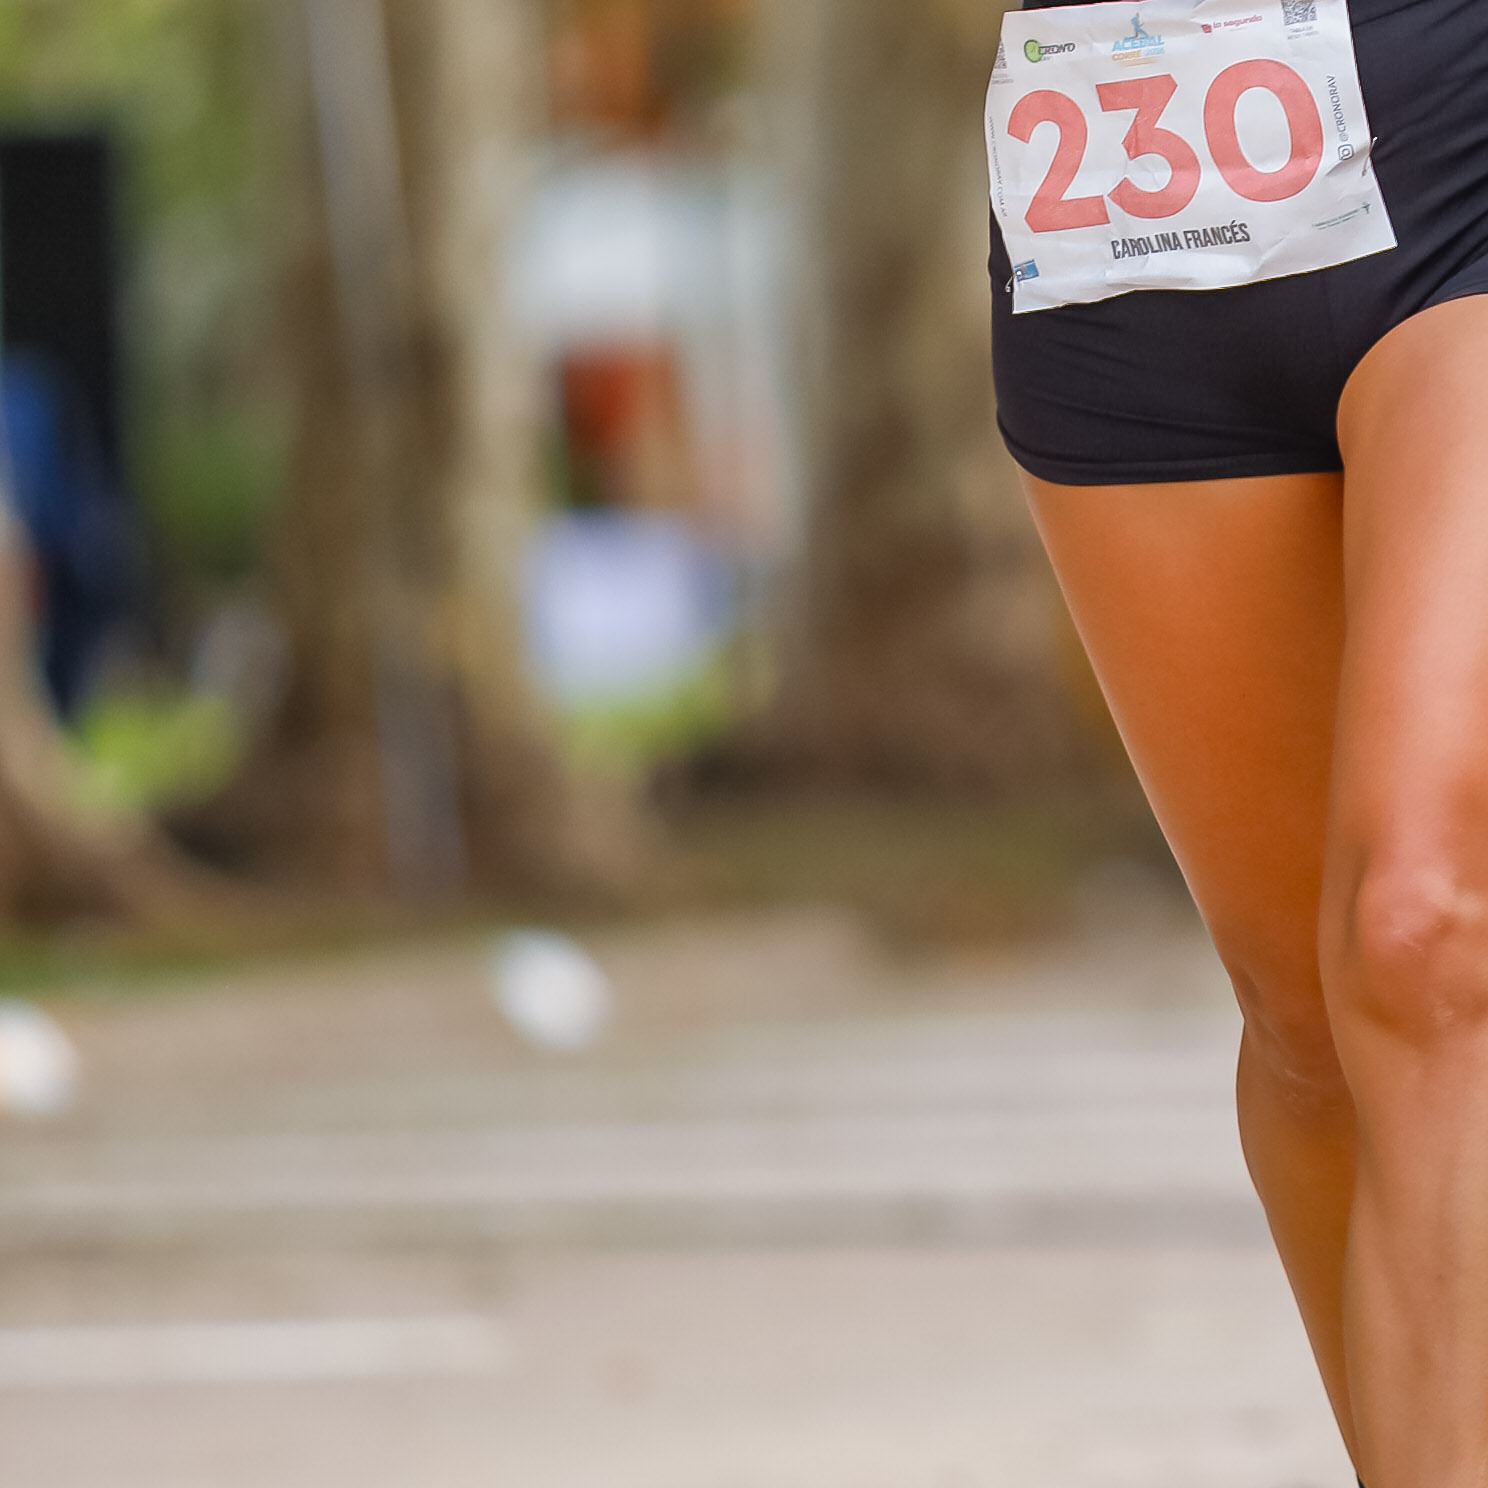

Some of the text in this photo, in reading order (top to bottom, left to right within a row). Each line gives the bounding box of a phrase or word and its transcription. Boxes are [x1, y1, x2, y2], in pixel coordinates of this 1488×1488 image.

[1007, 58, 1323, 233] 230
[1111, 219, 1251, 260] CAROLINA FRANCÉS
